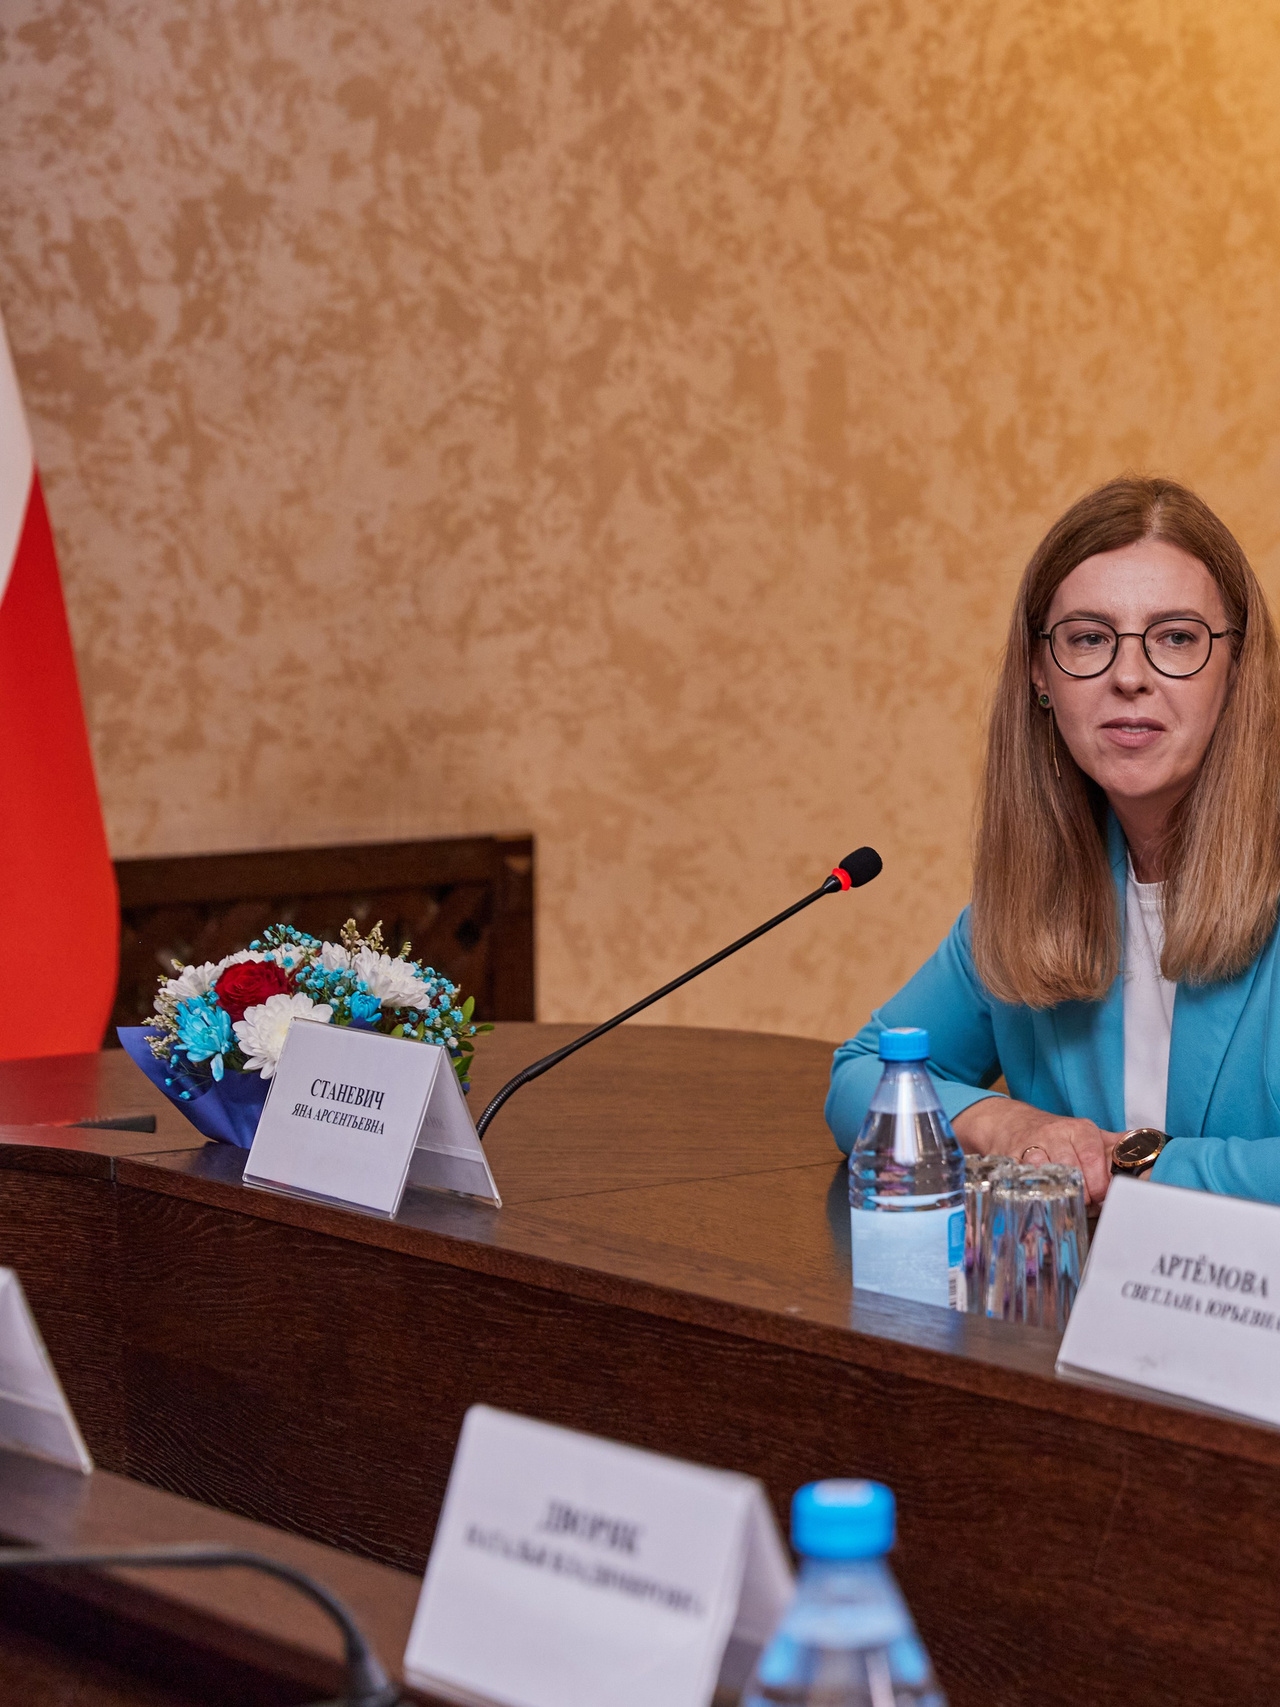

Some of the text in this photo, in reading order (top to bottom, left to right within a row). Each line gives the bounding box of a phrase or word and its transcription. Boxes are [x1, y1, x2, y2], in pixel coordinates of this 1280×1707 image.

[310, 1078, 386, 1111] СТАНЕВИЧ
[291, 1102, 385, 1135] ЯНА АРСЕНТЬЕВНА
[1152, 1253, 1269, 1298] АРТЁМОВА
[1121, 1280, 1201, 1314] СВЕТЛАНА
